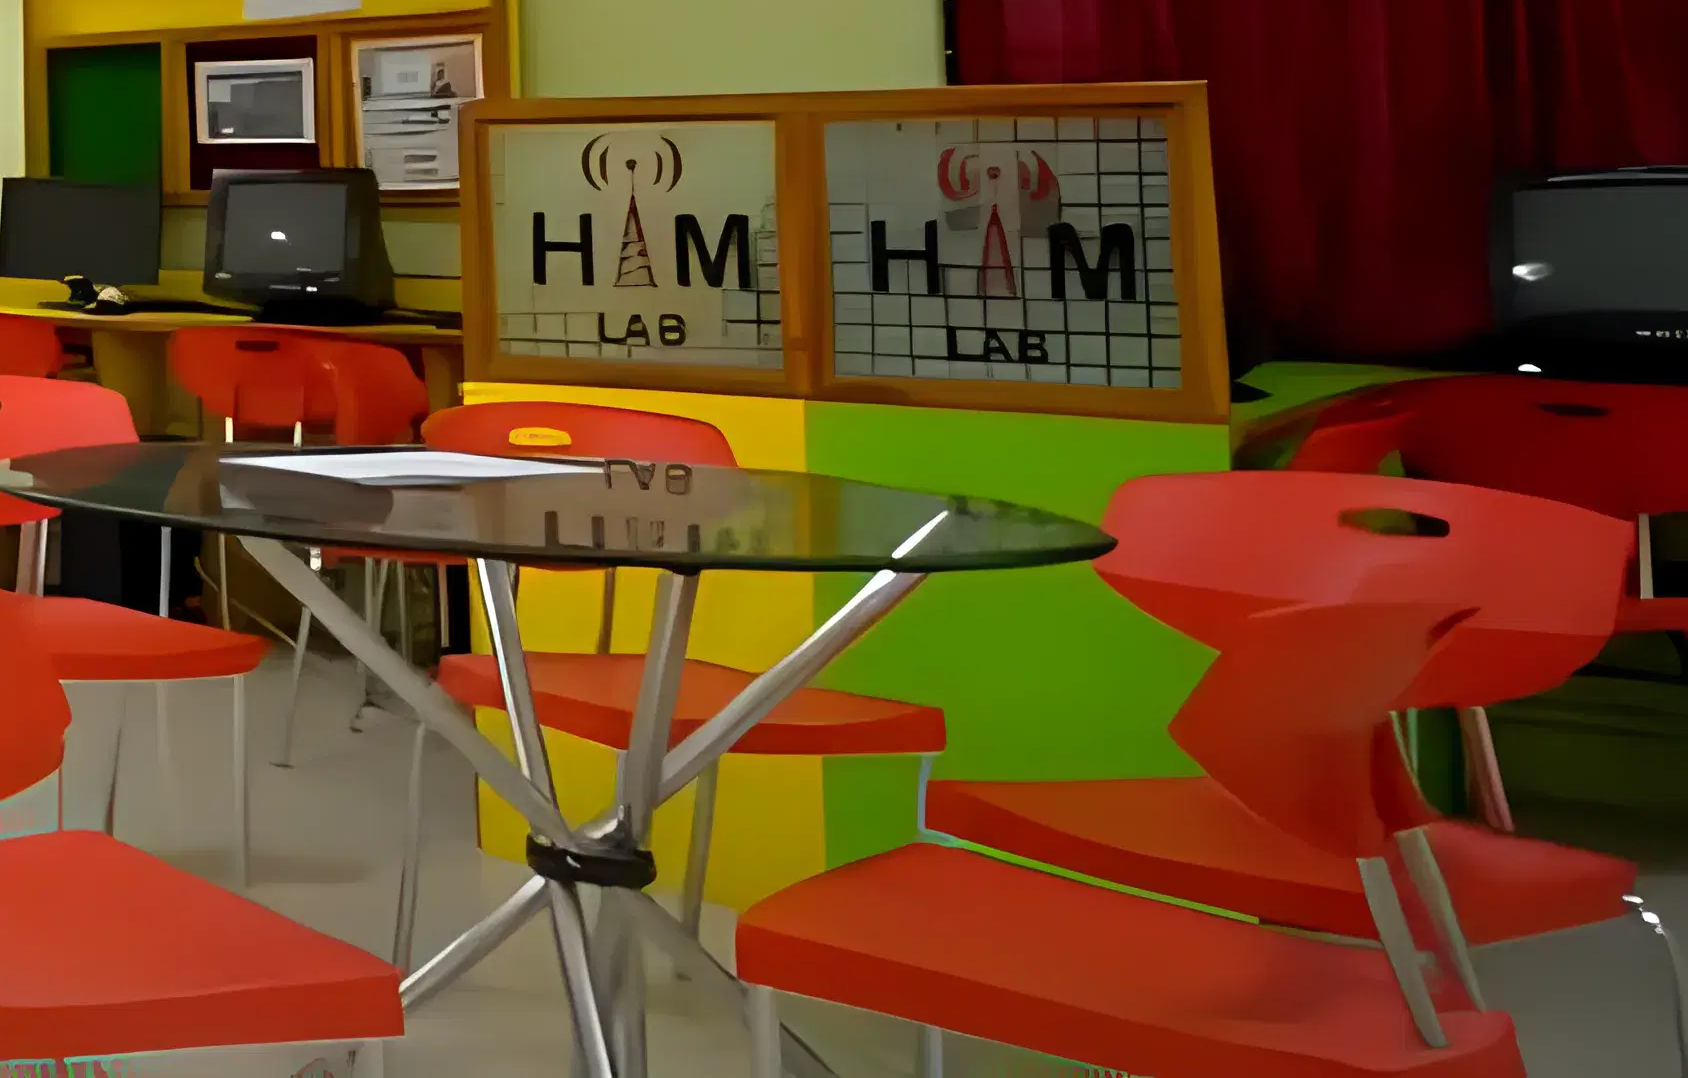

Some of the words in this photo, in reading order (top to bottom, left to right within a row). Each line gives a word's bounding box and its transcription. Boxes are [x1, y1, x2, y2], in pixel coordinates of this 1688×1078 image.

[533, 196, 751, 288] HAM
[871, 205, 1136, 300] HAM
[598, 313, 686, 347] LAB
[947, 326, 1049, 364] LAB
